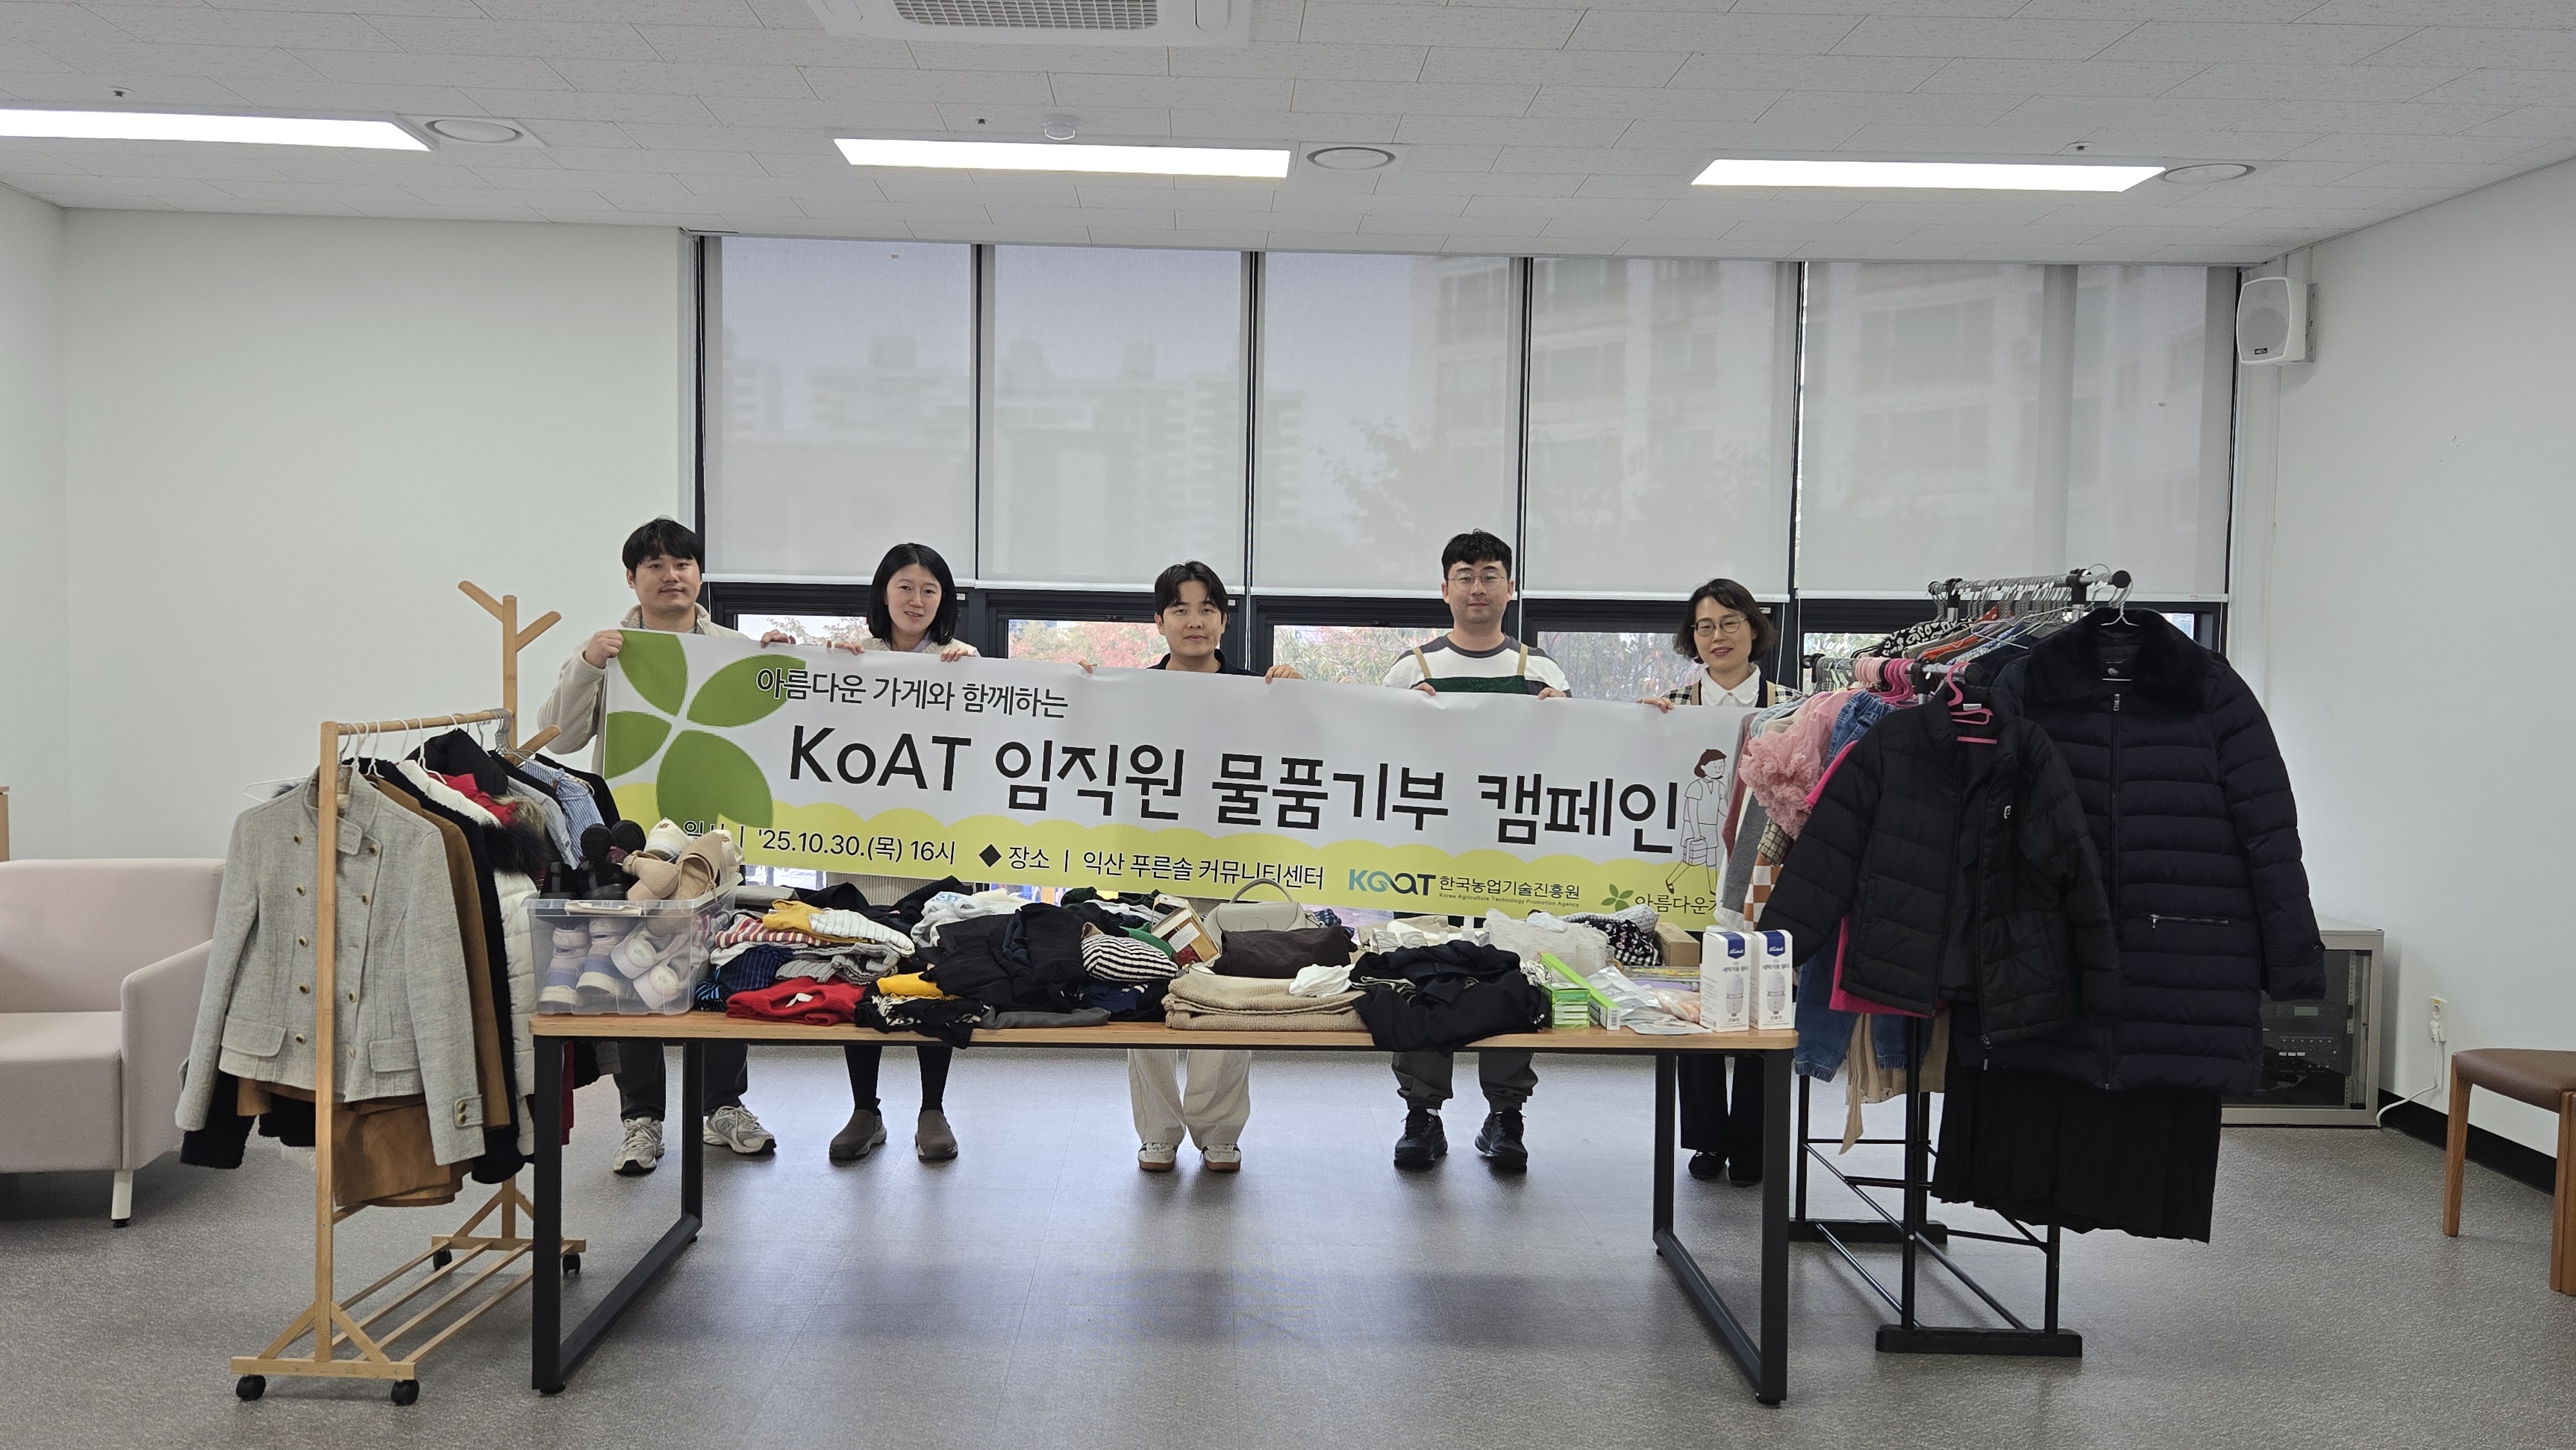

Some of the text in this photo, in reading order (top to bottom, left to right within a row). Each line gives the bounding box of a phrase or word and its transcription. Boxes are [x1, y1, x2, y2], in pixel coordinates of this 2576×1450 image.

[757, 668, 1069, 719] 아름다운 가게와 함께하는
[790, 725, 1678, 854] KoAT 임직원 물품기부 캠페인
[910, 840, 956, 865] 16시
[1009, 846, 1050, 870] 장소
[1083, 851, 1126, 877] 익산
[1130, 854, 1193, 881] 푸른솔
[1198, 859, 1323, 890] 커뮤니티센터
[1439, 876, 1580, 899] 한국농업기술진흥원
